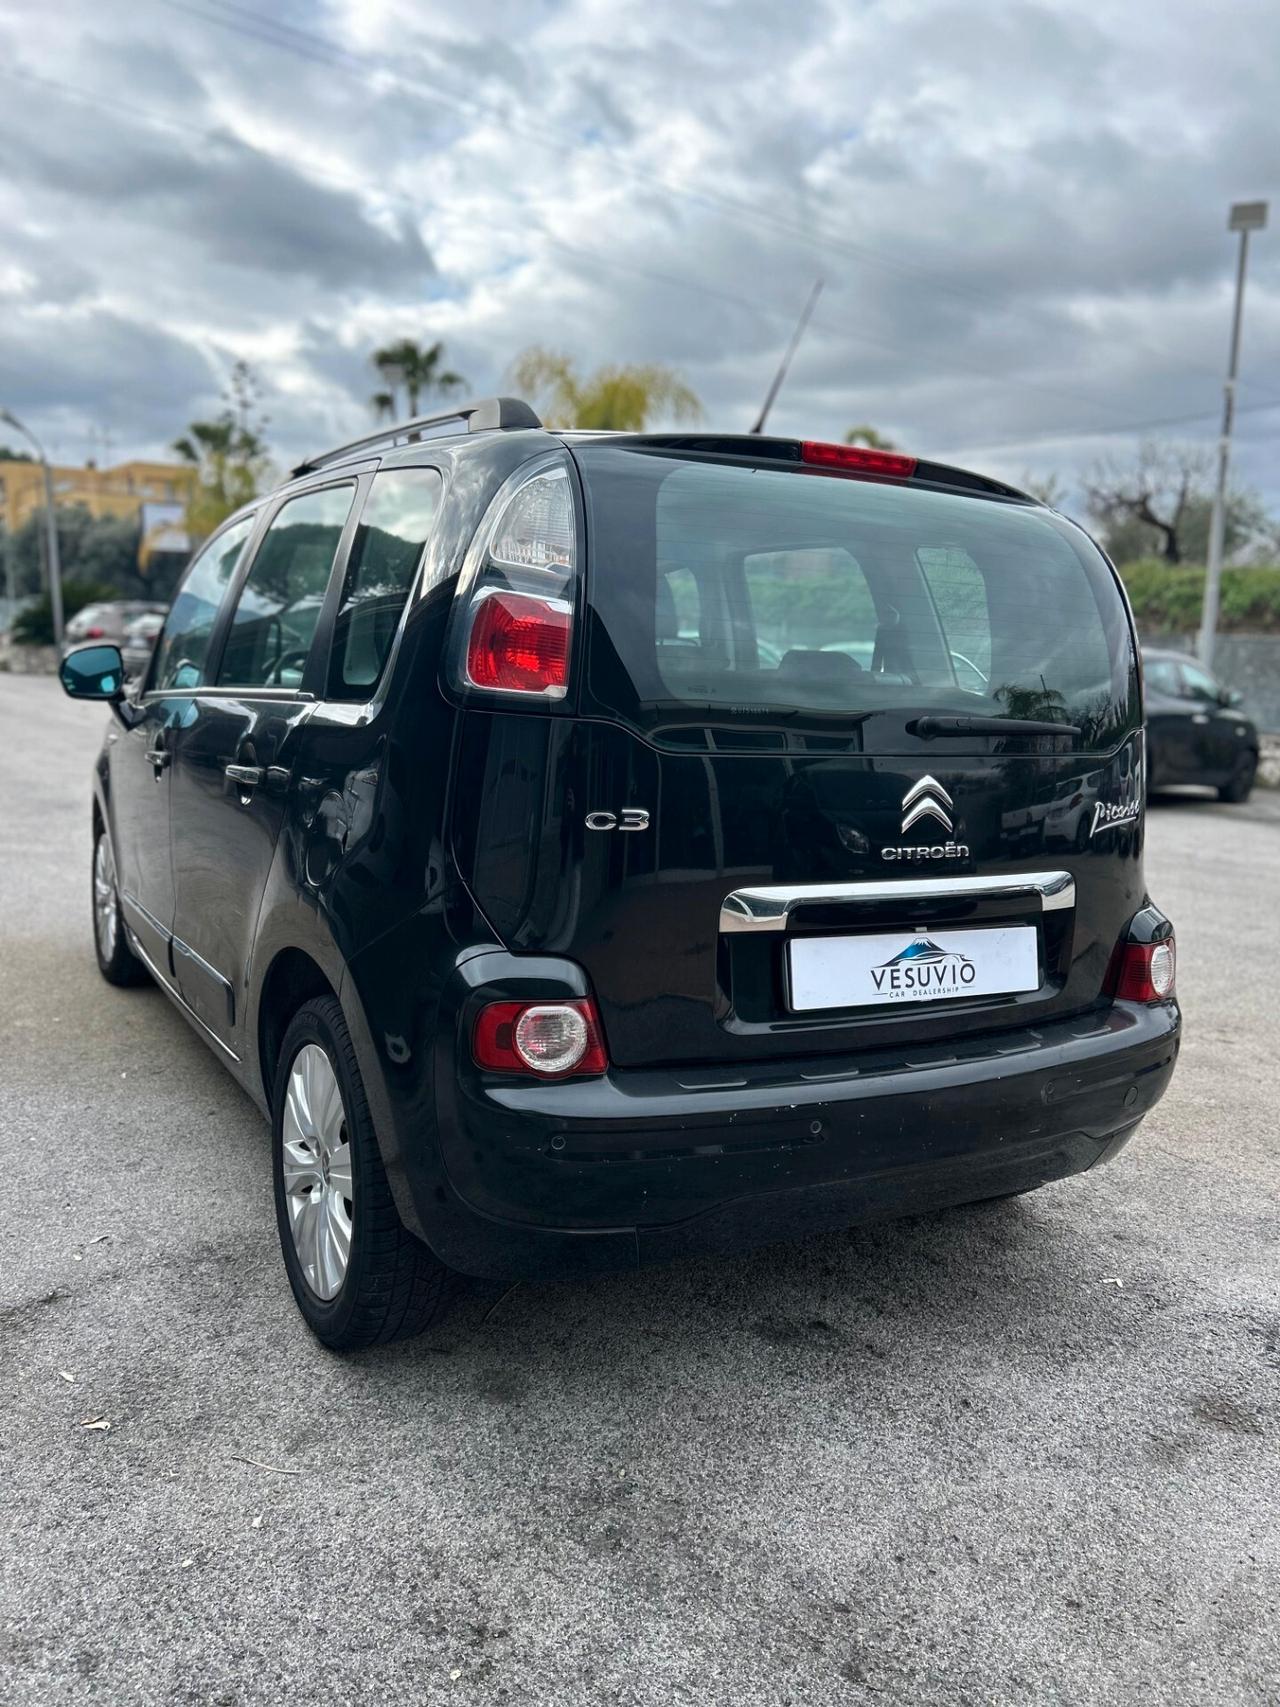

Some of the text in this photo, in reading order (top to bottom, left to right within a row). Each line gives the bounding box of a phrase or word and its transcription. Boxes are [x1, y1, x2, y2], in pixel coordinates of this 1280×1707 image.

[585, 809, 649, 830] C3
[871, 963, 975, 991] VESUVIO
[889, 986, 959, 998] CAR DEALERSHIP
